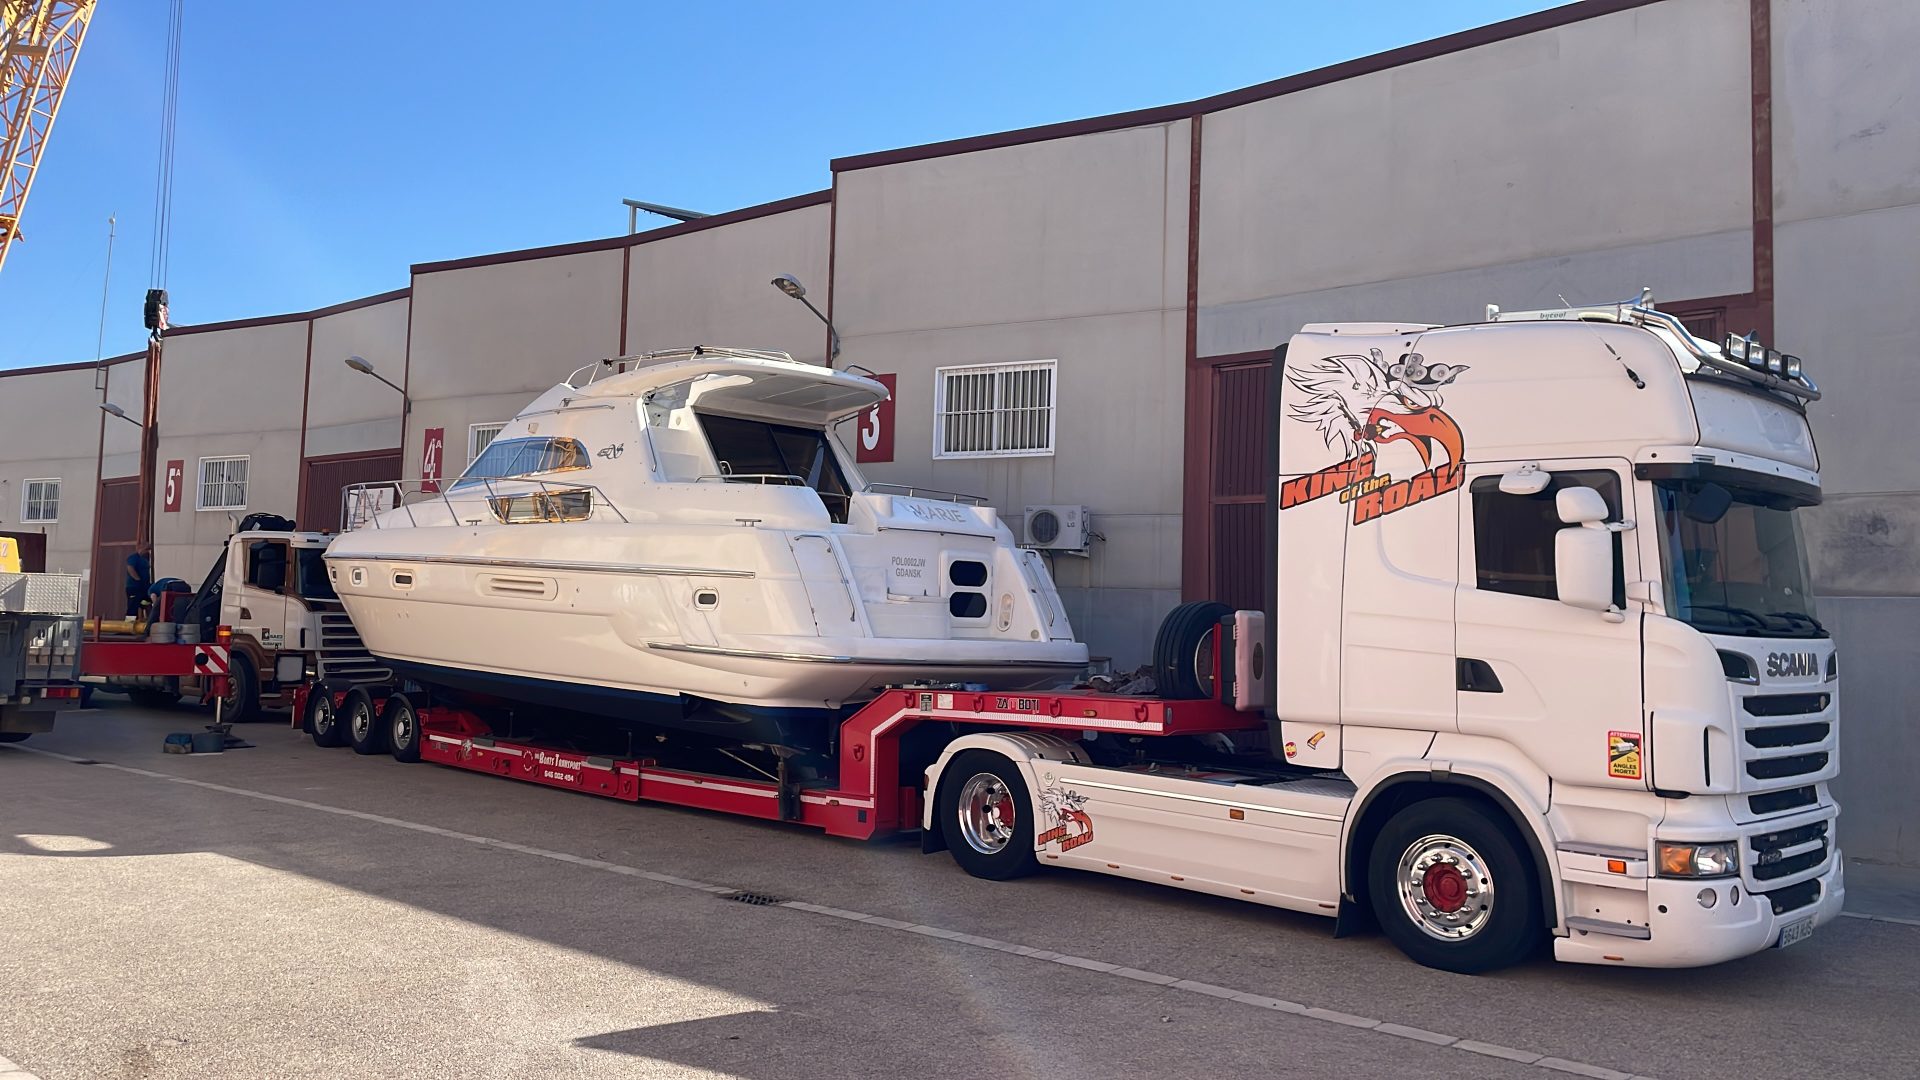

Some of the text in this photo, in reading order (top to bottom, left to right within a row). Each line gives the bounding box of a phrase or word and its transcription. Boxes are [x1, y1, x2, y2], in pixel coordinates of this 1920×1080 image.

[1280, 451, 1376, 510] KING
[1353, 458, 1466, 526] ROAD
[1361, 473, 1392, 494] the
[895, 567, 922, 578] GDANSK
[1766, 652, 1818, 677] SCANIA
